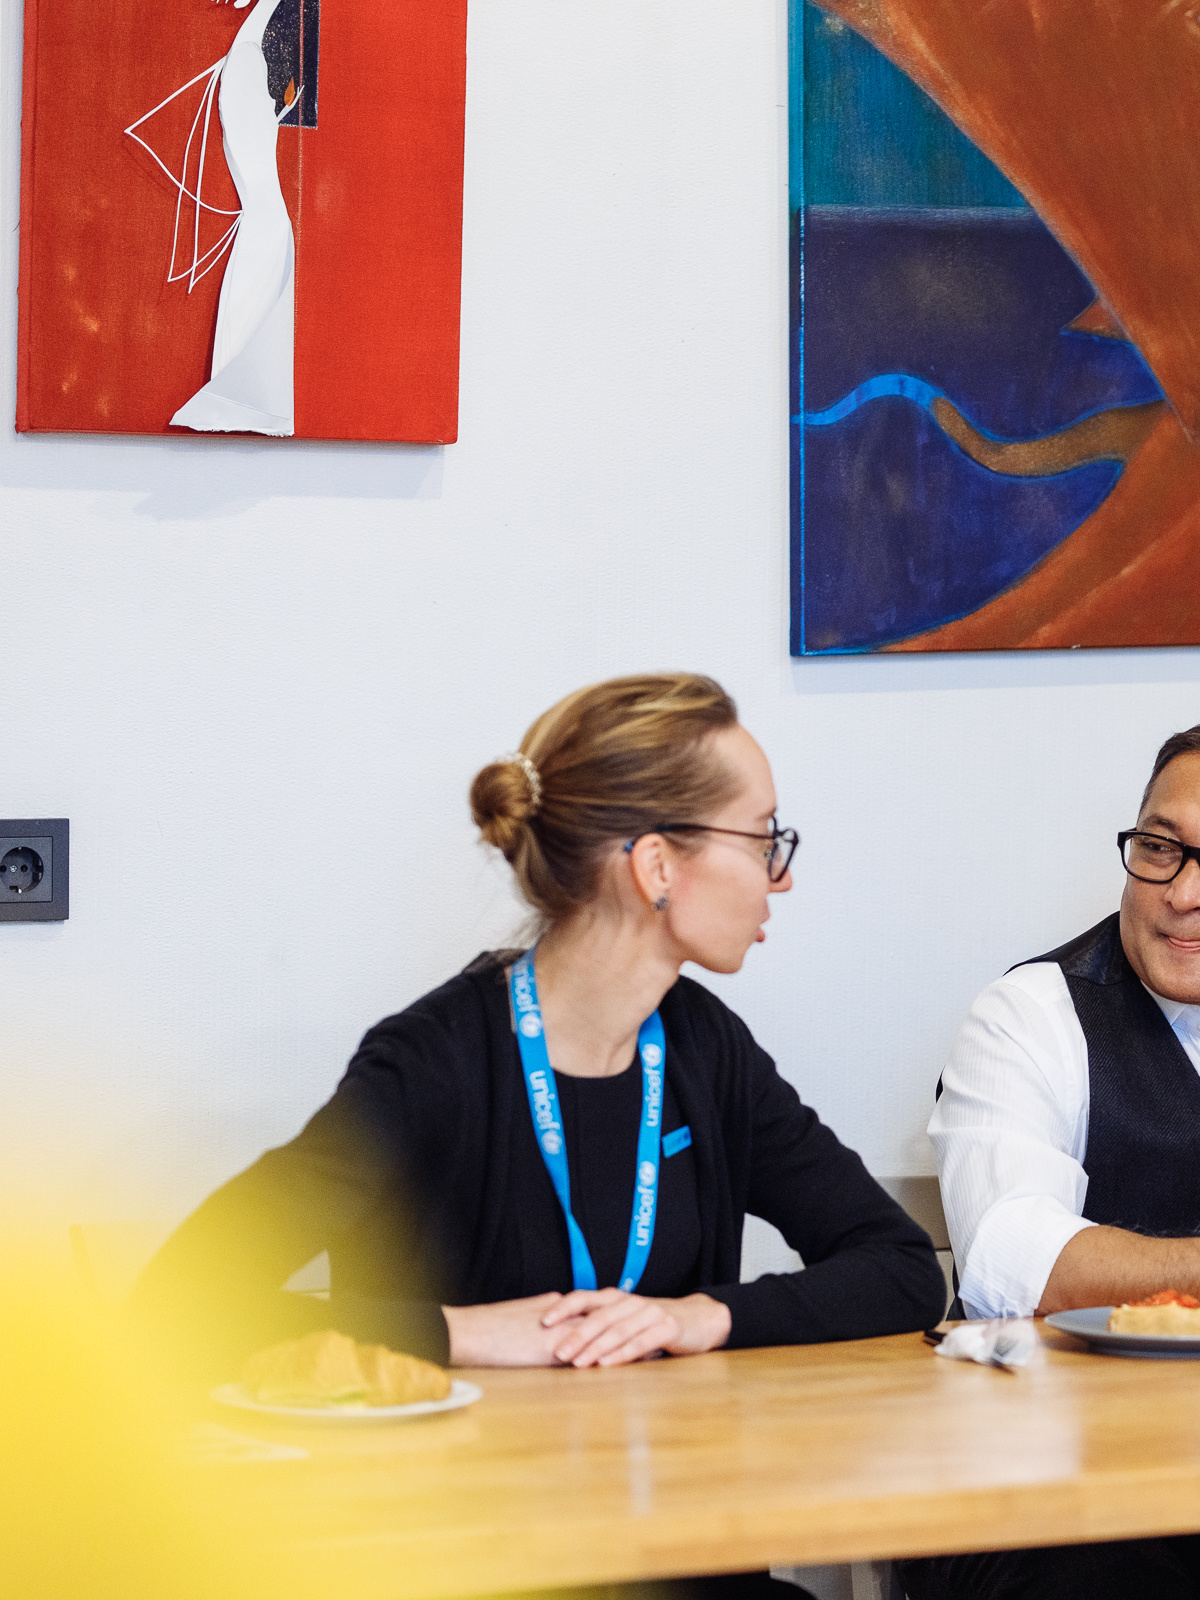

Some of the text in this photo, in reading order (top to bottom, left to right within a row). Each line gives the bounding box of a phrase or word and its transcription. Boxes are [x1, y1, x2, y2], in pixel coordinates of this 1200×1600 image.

[530, 1070, 560, 1130] unicef
[643, 1065, 661, 1127] unicef
[634, 1184, 655, 1246] unicef
